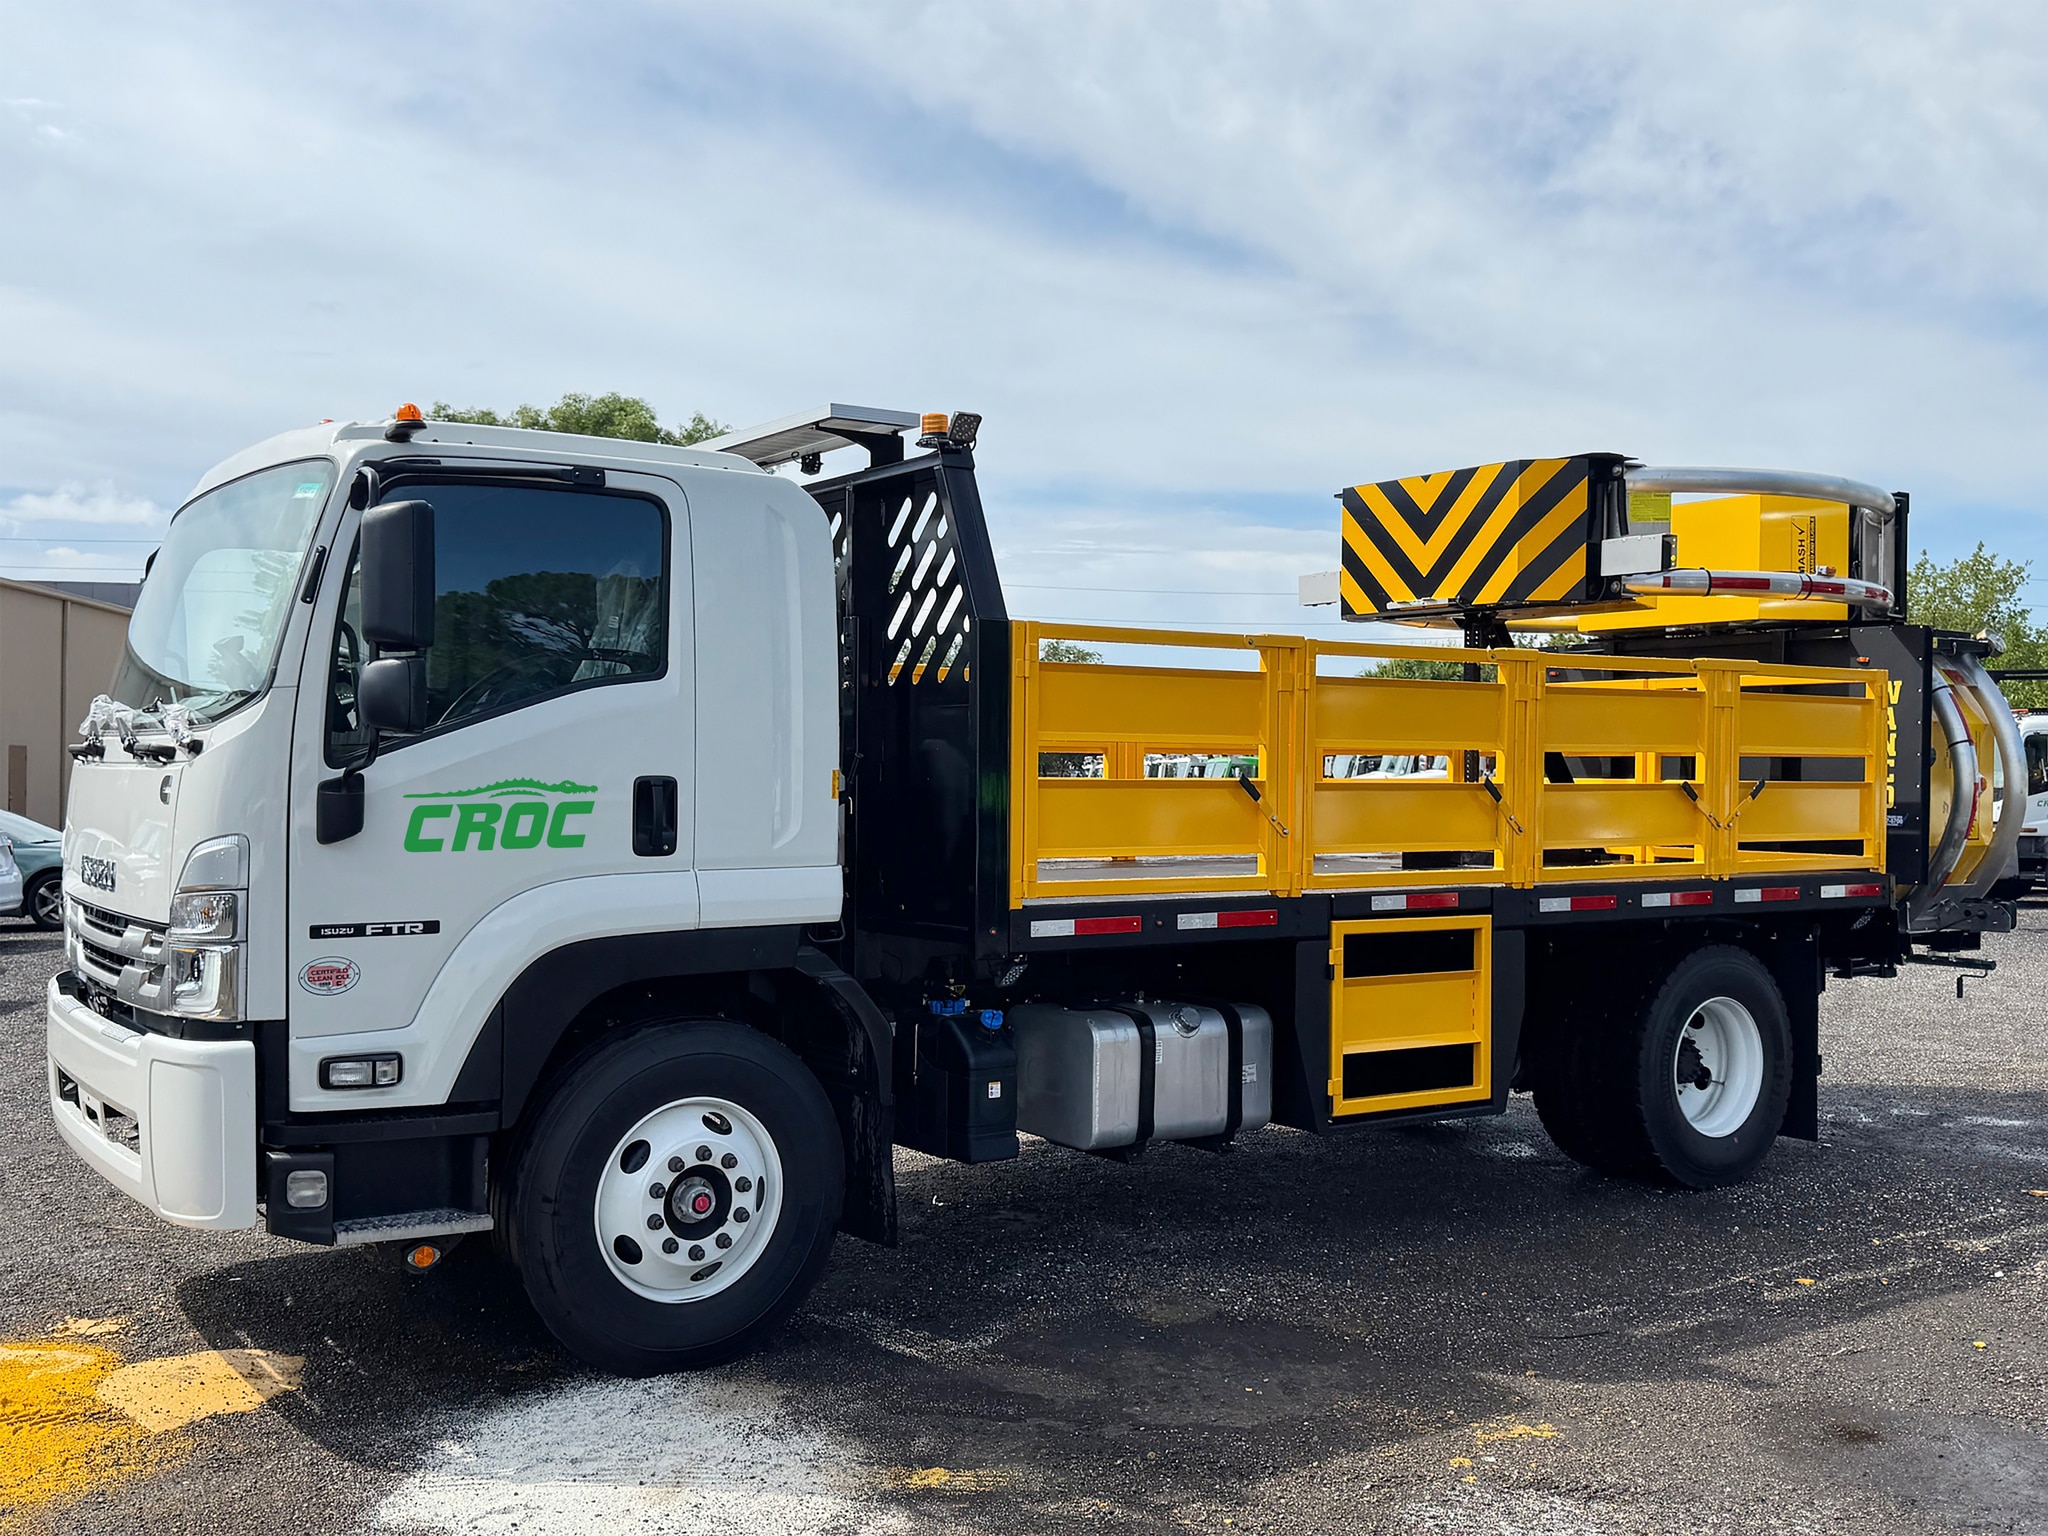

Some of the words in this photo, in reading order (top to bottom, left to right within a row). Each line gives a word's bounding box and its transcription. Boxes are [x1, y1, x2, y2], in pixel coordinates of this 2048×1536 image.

[403, 801, 595, 852] CROC
[321, 927, 354, 936] ISUZU
[365, 922, 425, 936] FTR
